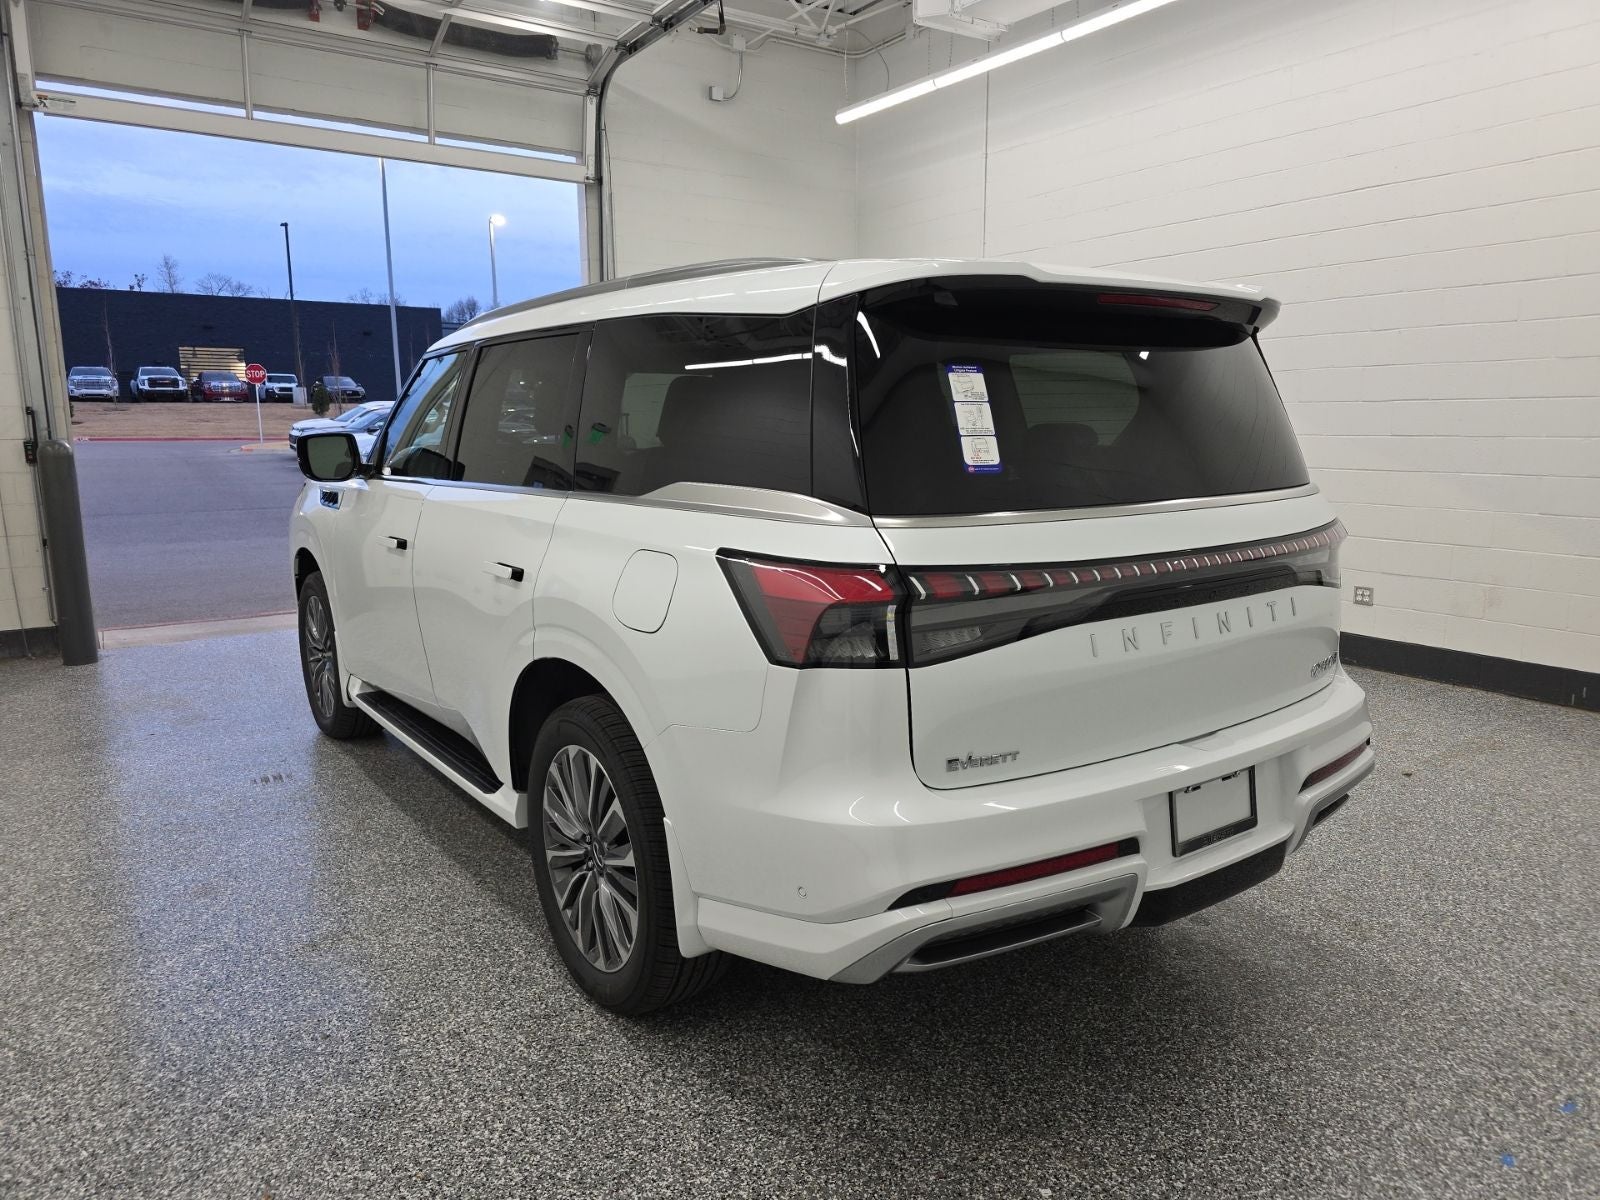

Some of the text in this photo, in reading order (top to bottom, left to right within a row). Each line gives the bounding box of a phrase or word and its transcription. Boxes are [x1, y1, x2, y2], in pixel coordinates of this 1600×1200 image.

[246, 370, 265, 378] STOP
[1090, 597, 1296, 658] INFINITI
[946, 750, 1020, 773] EVERETT
